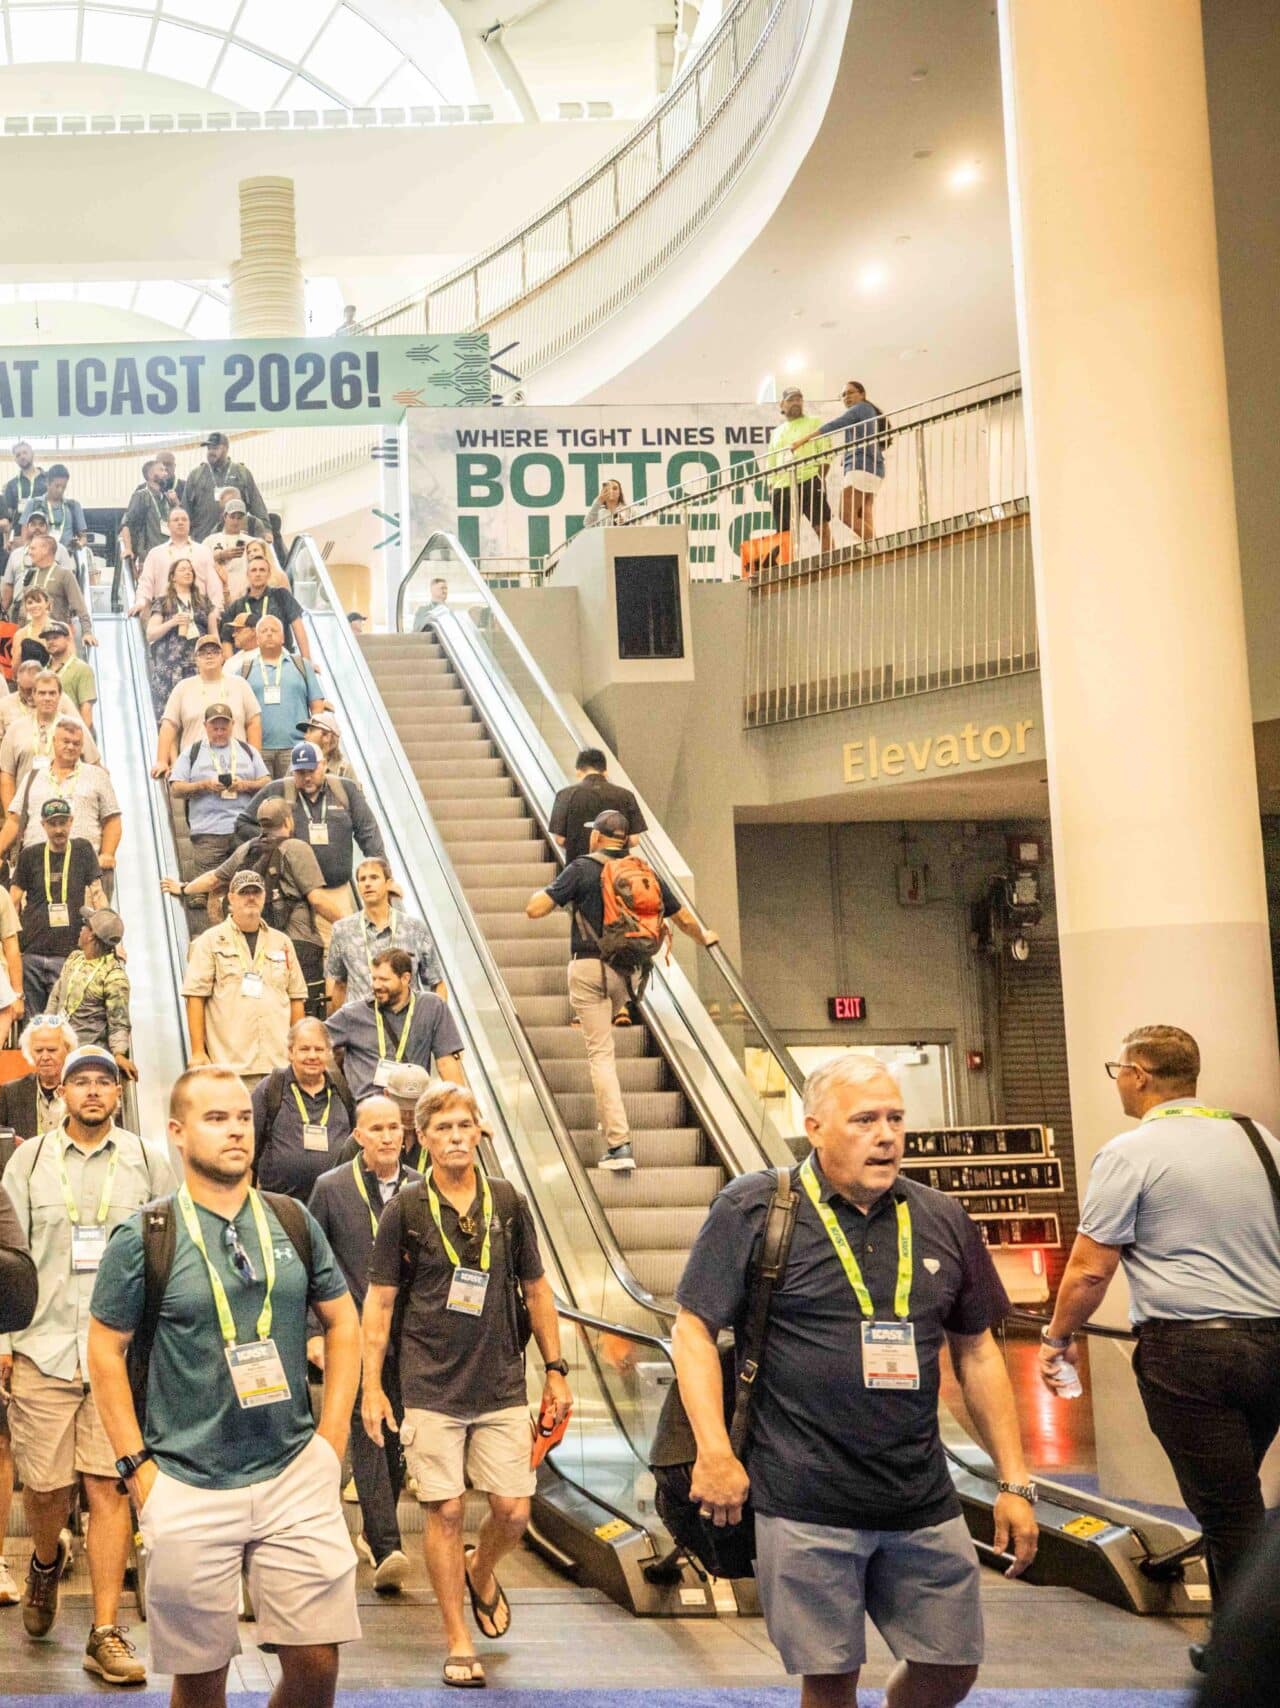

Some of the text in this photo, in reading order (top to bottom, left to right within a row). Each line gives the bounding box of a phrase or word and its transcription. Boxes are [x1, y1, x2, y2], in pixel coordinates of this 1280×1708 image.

[56, 355, 206, 418] ICAST
[223, 351, 382, 413] 2026!
[456, 429, 549, 447] WHERE
[557, 428, 632, 447] TIGHT
[642, 426, 715, 445] LINES
[843, 719, 1035, 784] Elevator
[835, 998, 861, 1019] EXIT
